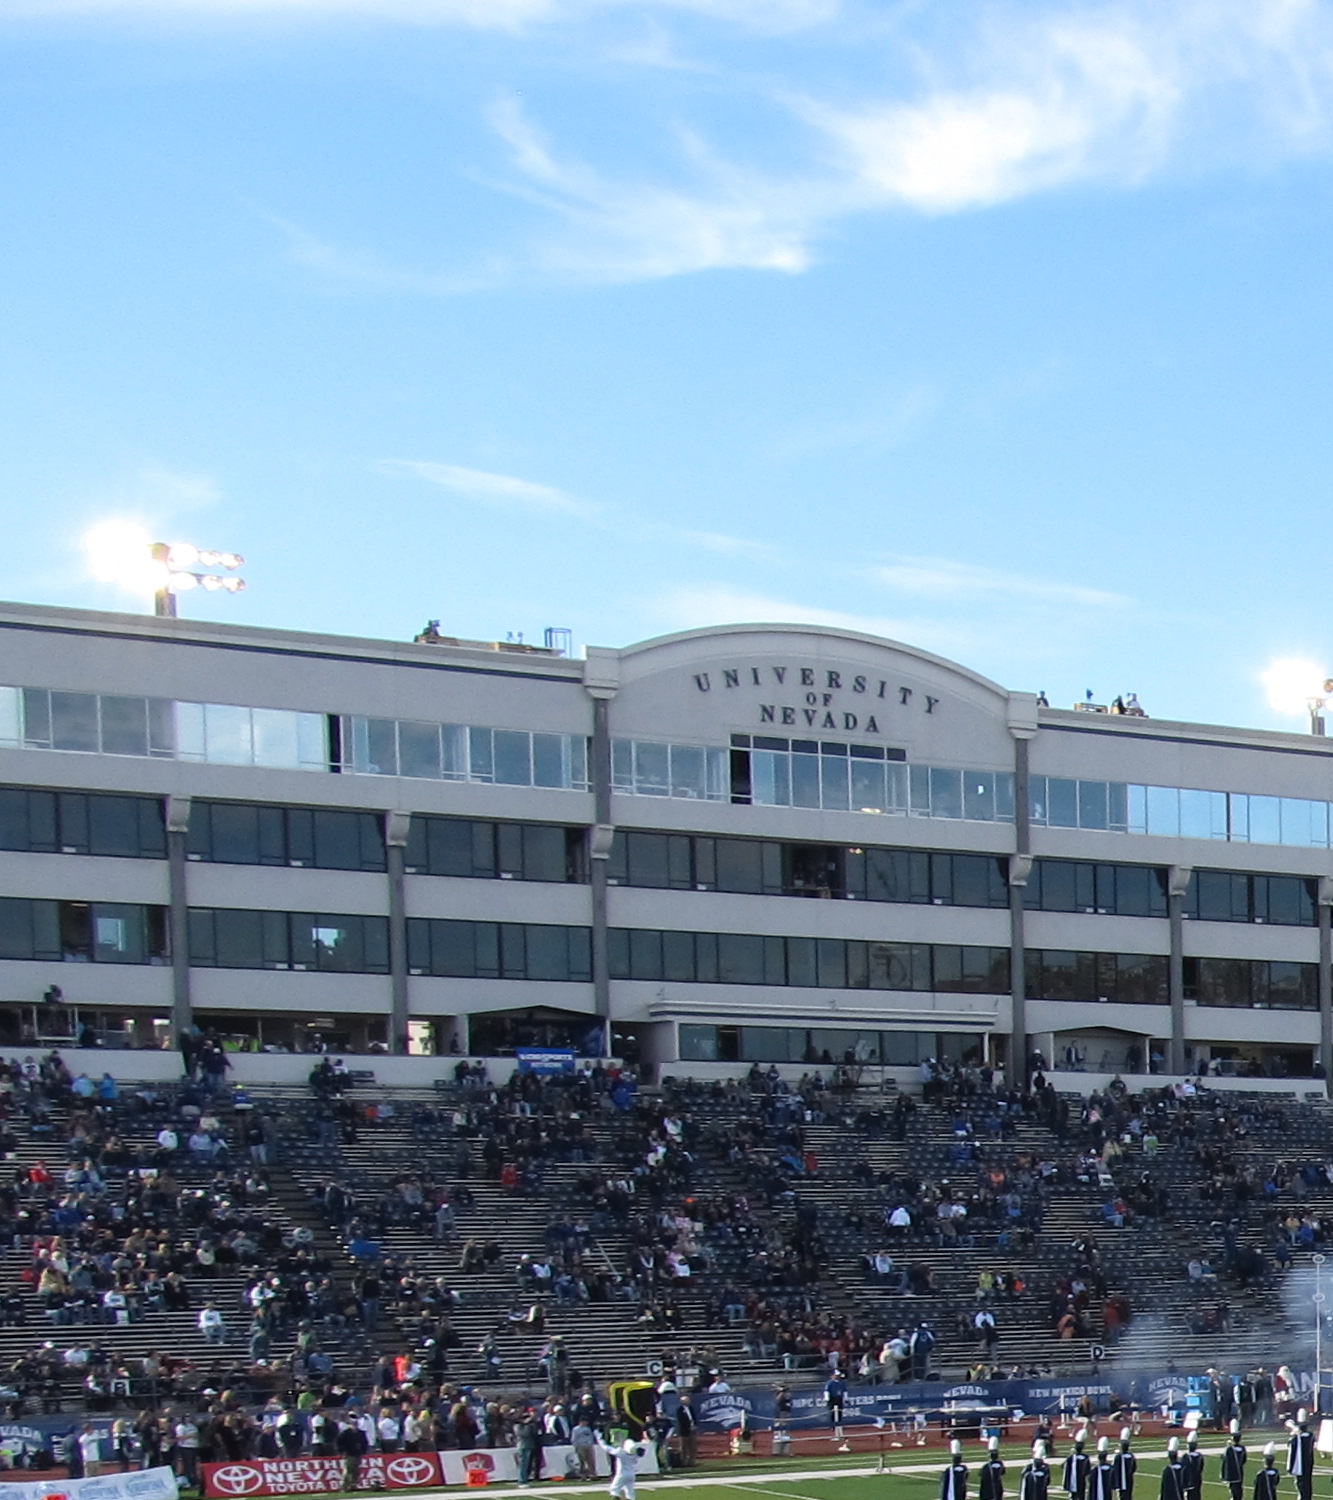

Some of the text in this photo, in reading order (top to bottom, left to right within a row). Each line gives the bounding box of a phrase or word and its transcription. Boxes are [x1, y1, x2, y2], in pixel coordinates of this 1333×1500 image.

[694, 665, 940, 716] UNIVERSITY
[805, 692, 832, 708] OF
[759, 703, 881, 734] NEVADA
[650, 1361, 662, 1374] C
[1148, 1376, 1187, 1391] NEVAD
[1028, 1388, 1050, 1398] NEW
[699, 1395, 753, 1413] NEVADA
[0, 1425, 43, 1443] VADA
[263, 1456, 385, 1473] NORTHRN
[265, 1468, 386, 1484] NEVAA
[268, 1481, 327, 1494] TOYOTA
